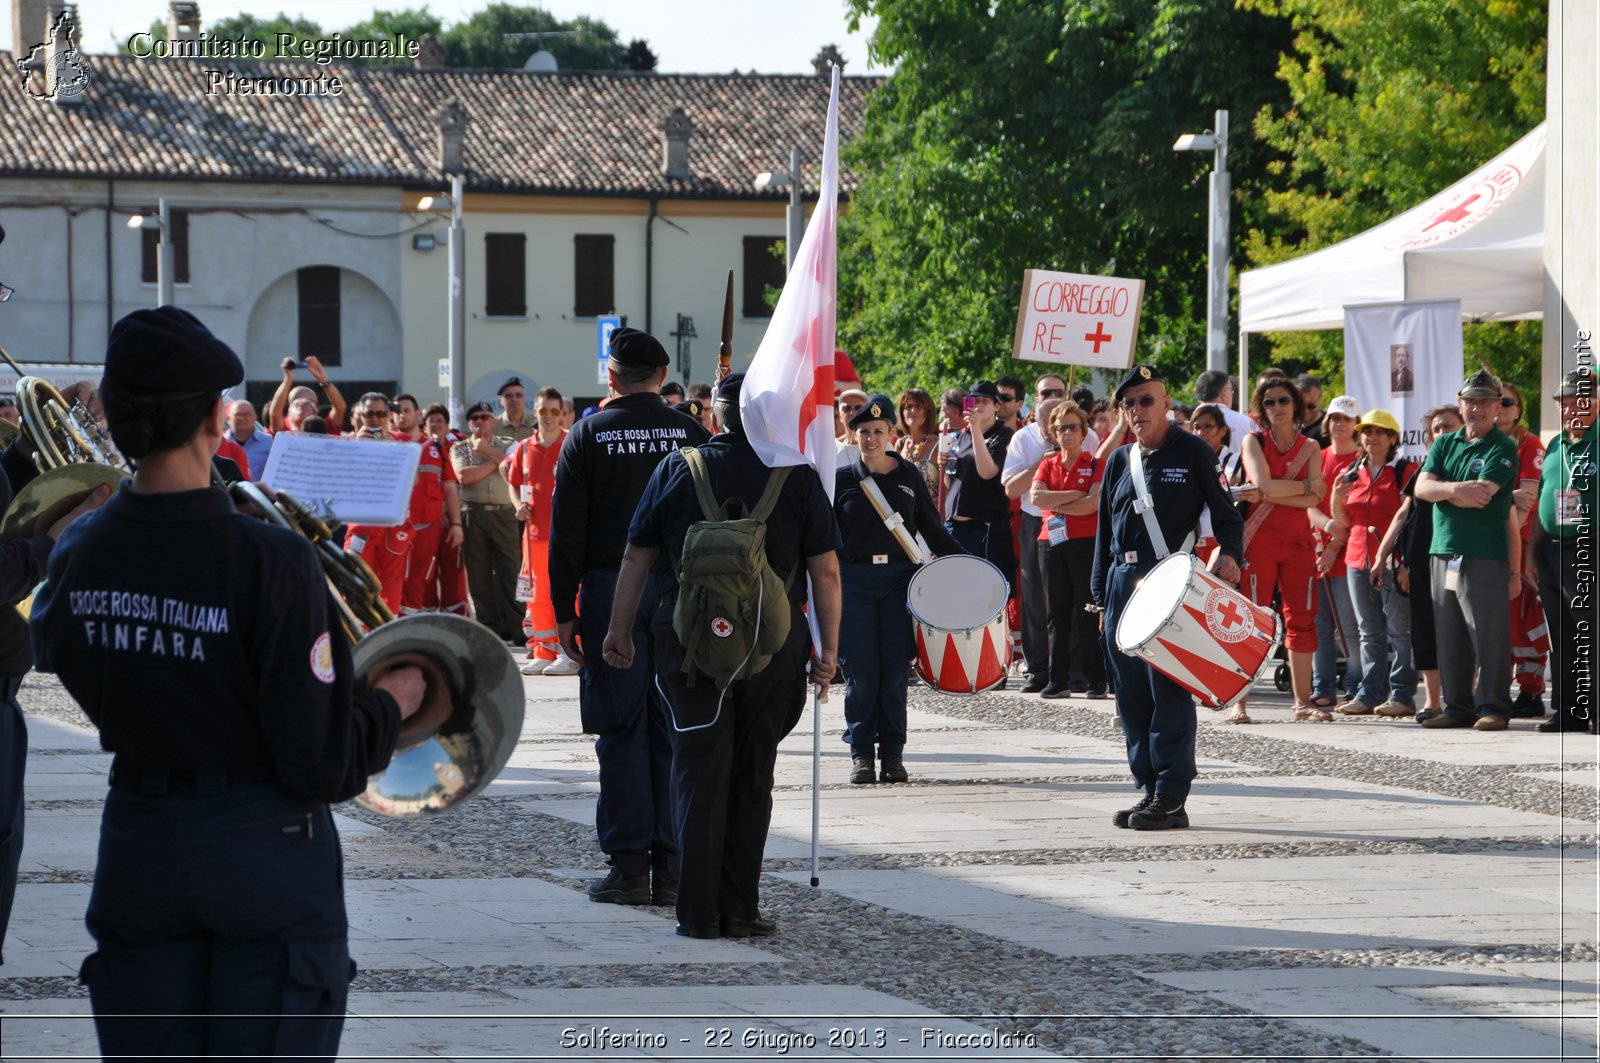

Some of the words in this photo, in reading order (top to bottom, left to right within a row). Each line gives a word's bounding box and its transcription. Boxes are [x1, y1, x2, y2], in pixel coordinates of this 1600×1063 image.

[1033, 281, 1129, 318] CORREGGIO
[595, 429, 623, 443] CROCE
[624, 429, 651, 440] ROSSA
[652, 428, 687, 440] ITALIANA
[607, 440, 680, 455] FANFARA
[69, 590, 108, 615] CROCE
[110, 591, 158, 622] ROSSA
[161, 597, 229, 634] ITALIANA
[84, 620, 205, 662] FANFARA
[1208, 622, 1249, 642] CONVENZIONE
